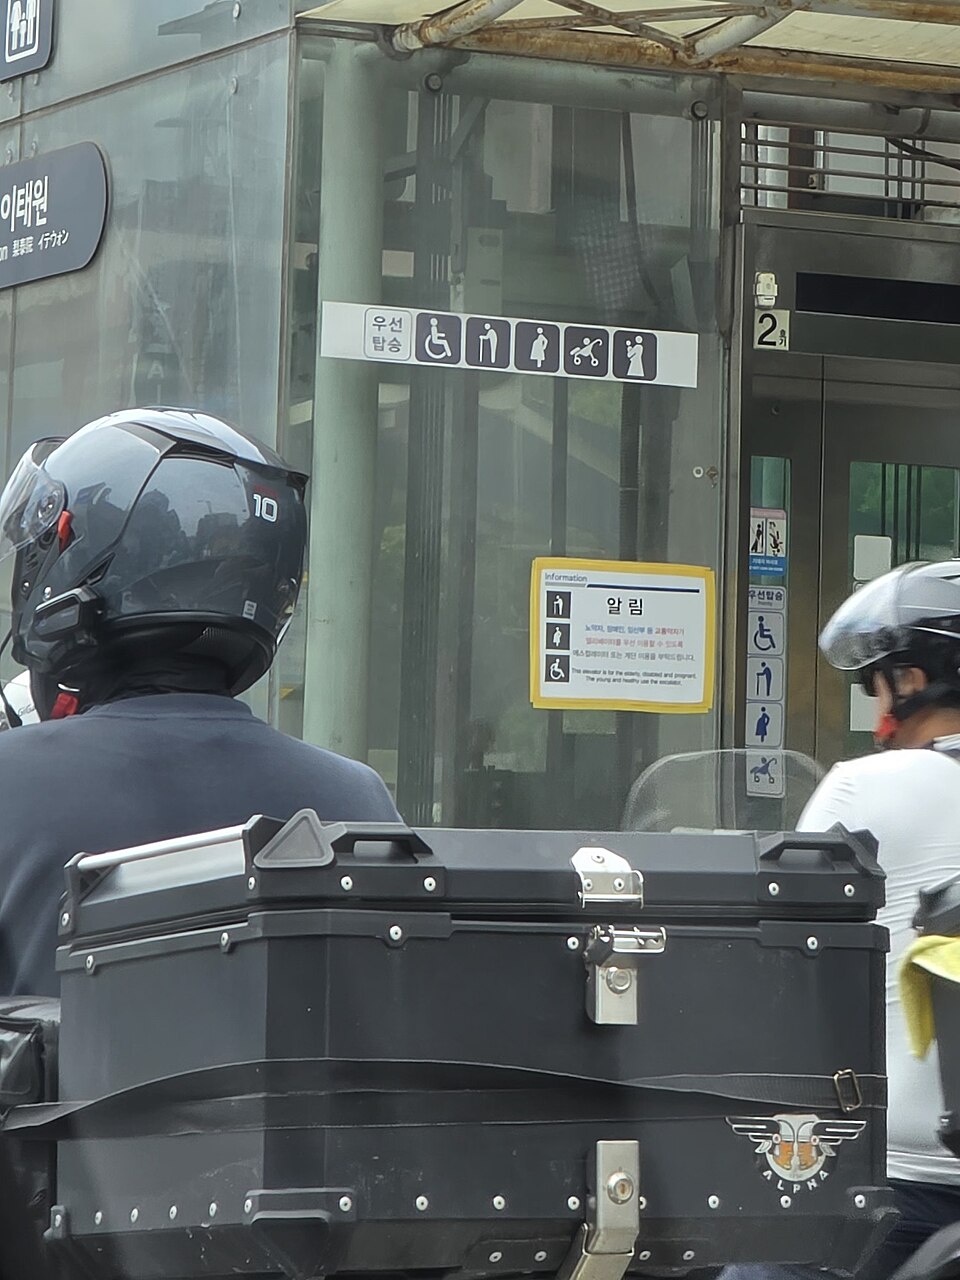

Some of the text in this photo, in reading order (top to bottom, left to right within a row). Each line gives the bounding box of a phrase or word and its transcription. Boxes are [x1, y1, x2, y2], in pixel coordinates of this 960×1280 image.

[0, 175, 48, 232] 이태원
[372, 315, 403, 333] 우선
[372, 336, 402, 353] 탑승
[253, 493, 278, 522] 10
[544, 572, 587, 582] Information
[762, 1170, 829, 1193] ALPHA
